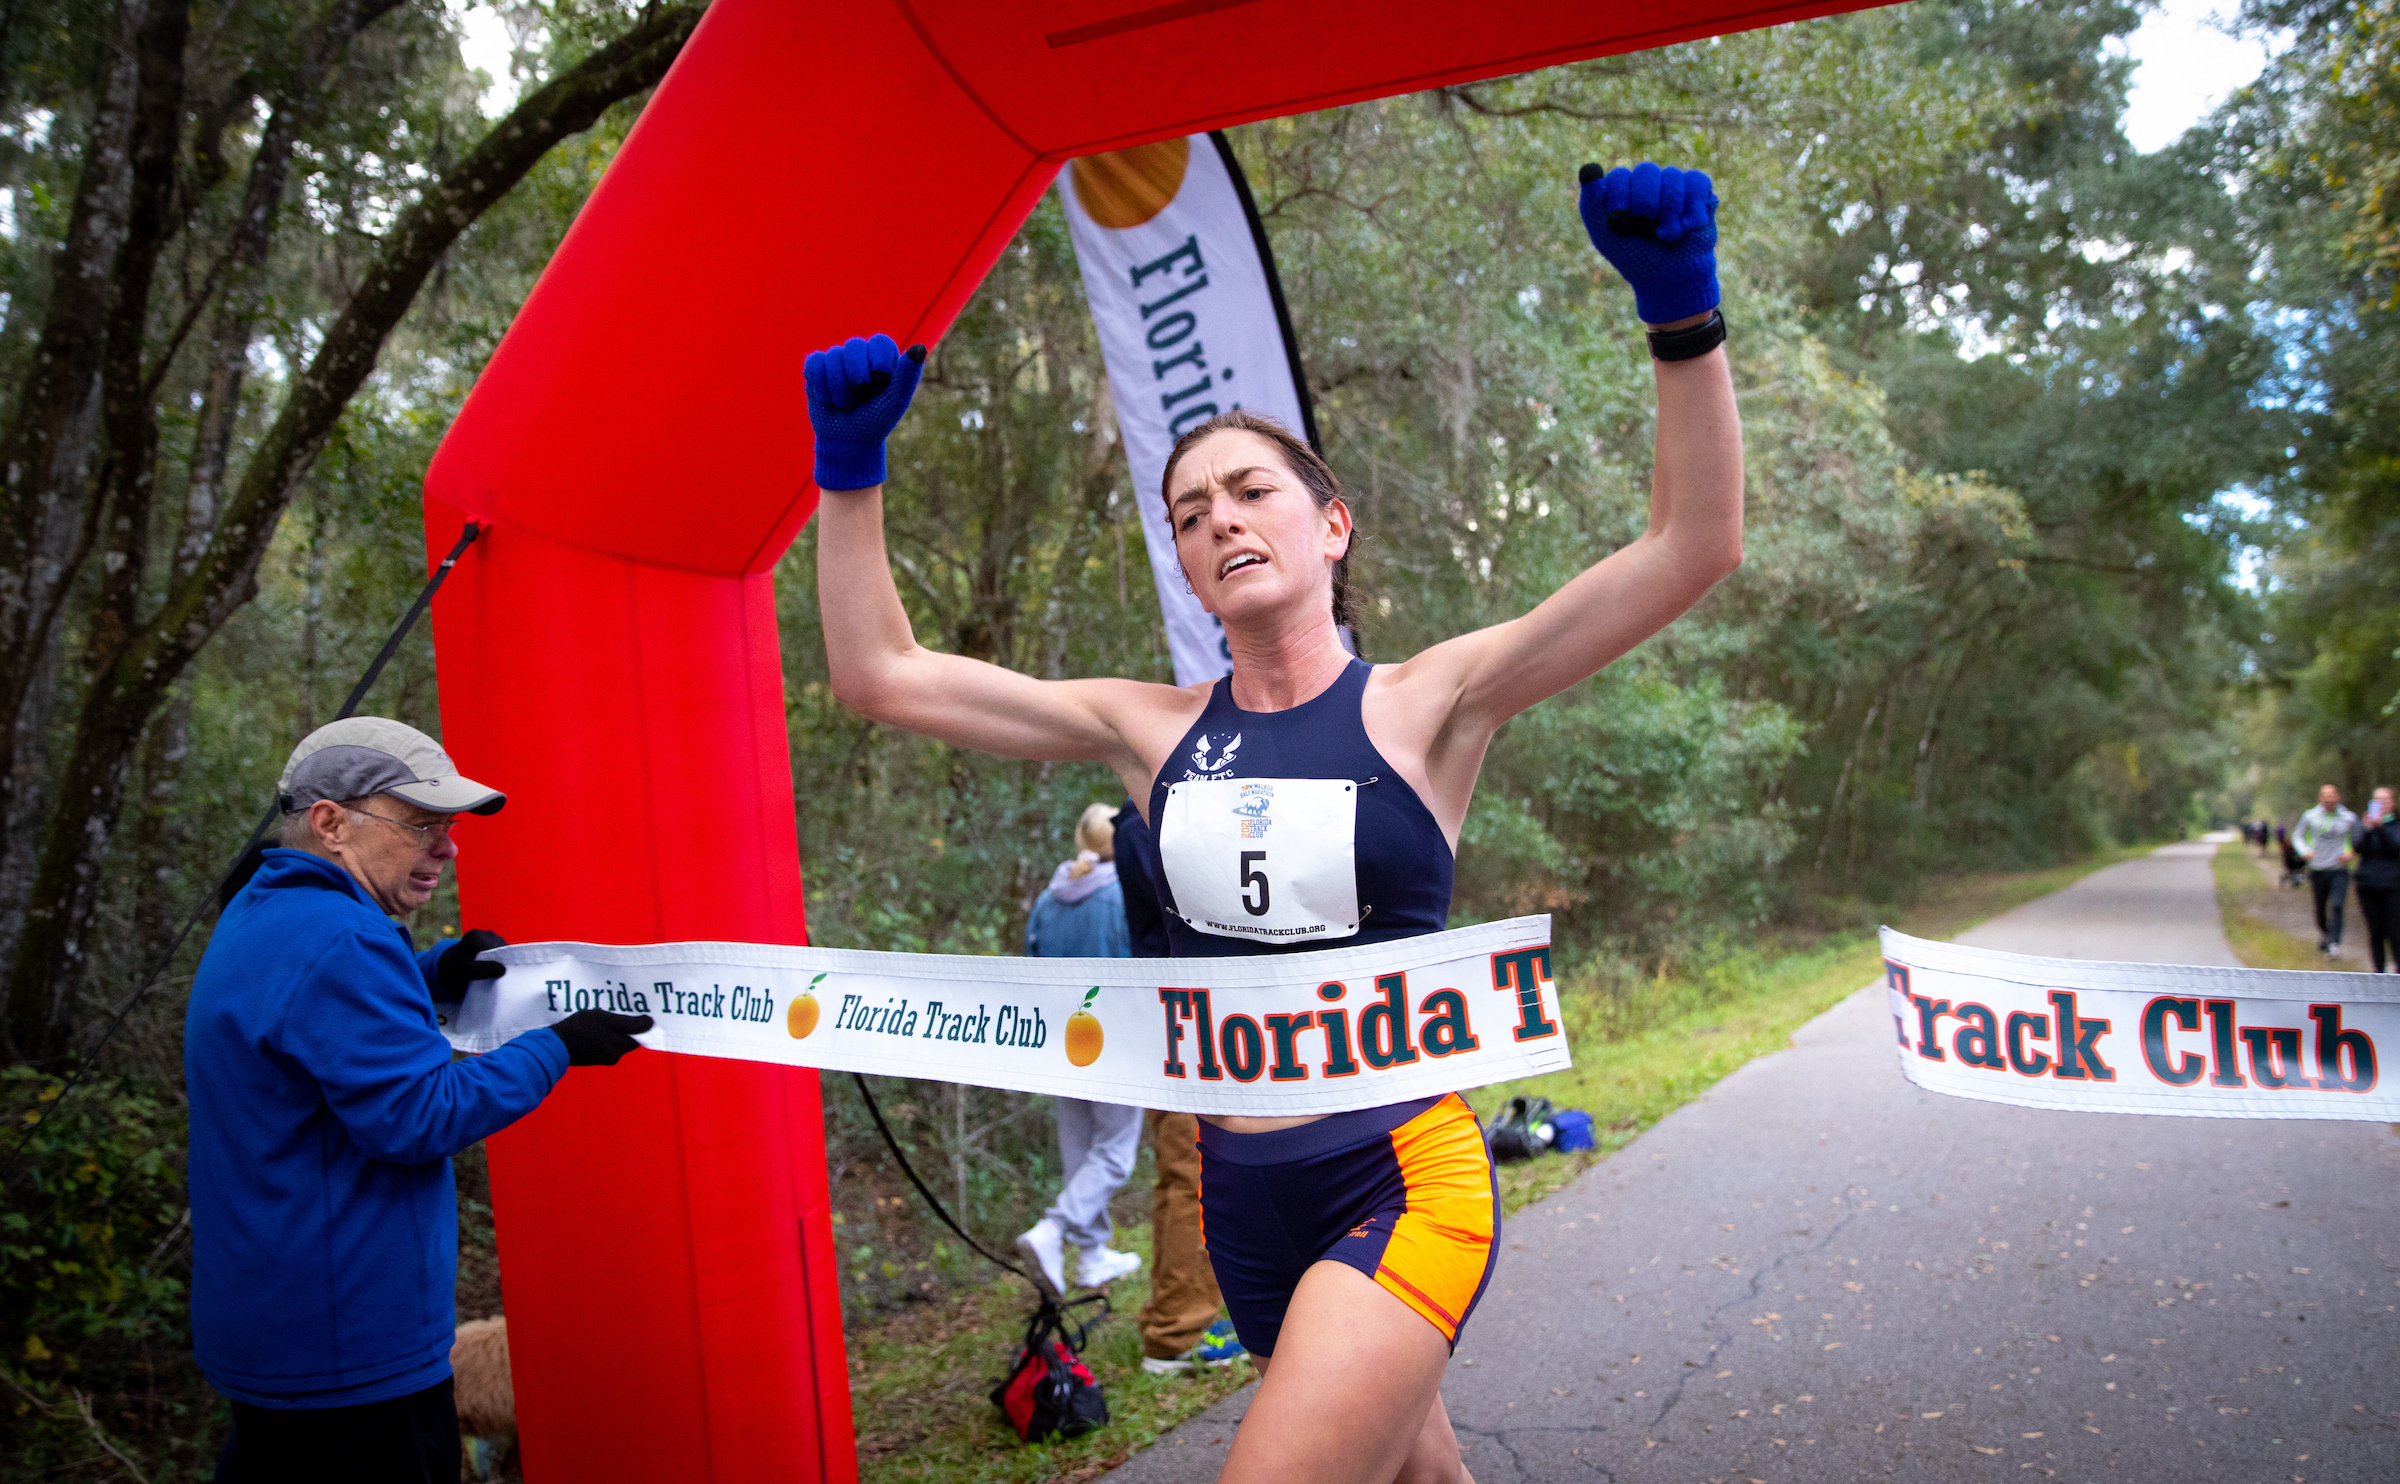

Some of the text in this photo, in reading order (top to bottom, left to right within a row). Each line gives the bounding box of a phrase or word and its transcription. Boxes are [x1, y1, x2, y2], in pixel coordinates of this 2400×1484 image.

[1183, 769, 1209, 781] TEAM
[1241, 819, 1250, 838] 2021
[1240, 851, 1270, 916] 5
[1205, 920, 1326, 937] WWW.FLORIDATRACKCLUB.ORG
[545, 980, 774, 1023] Florida Track Club
[835, 994, 1047, 1049] Florida Track Club
[1159, 971, 1479, 1083] Florida
[2140, 996, 2378, 1094] Club
